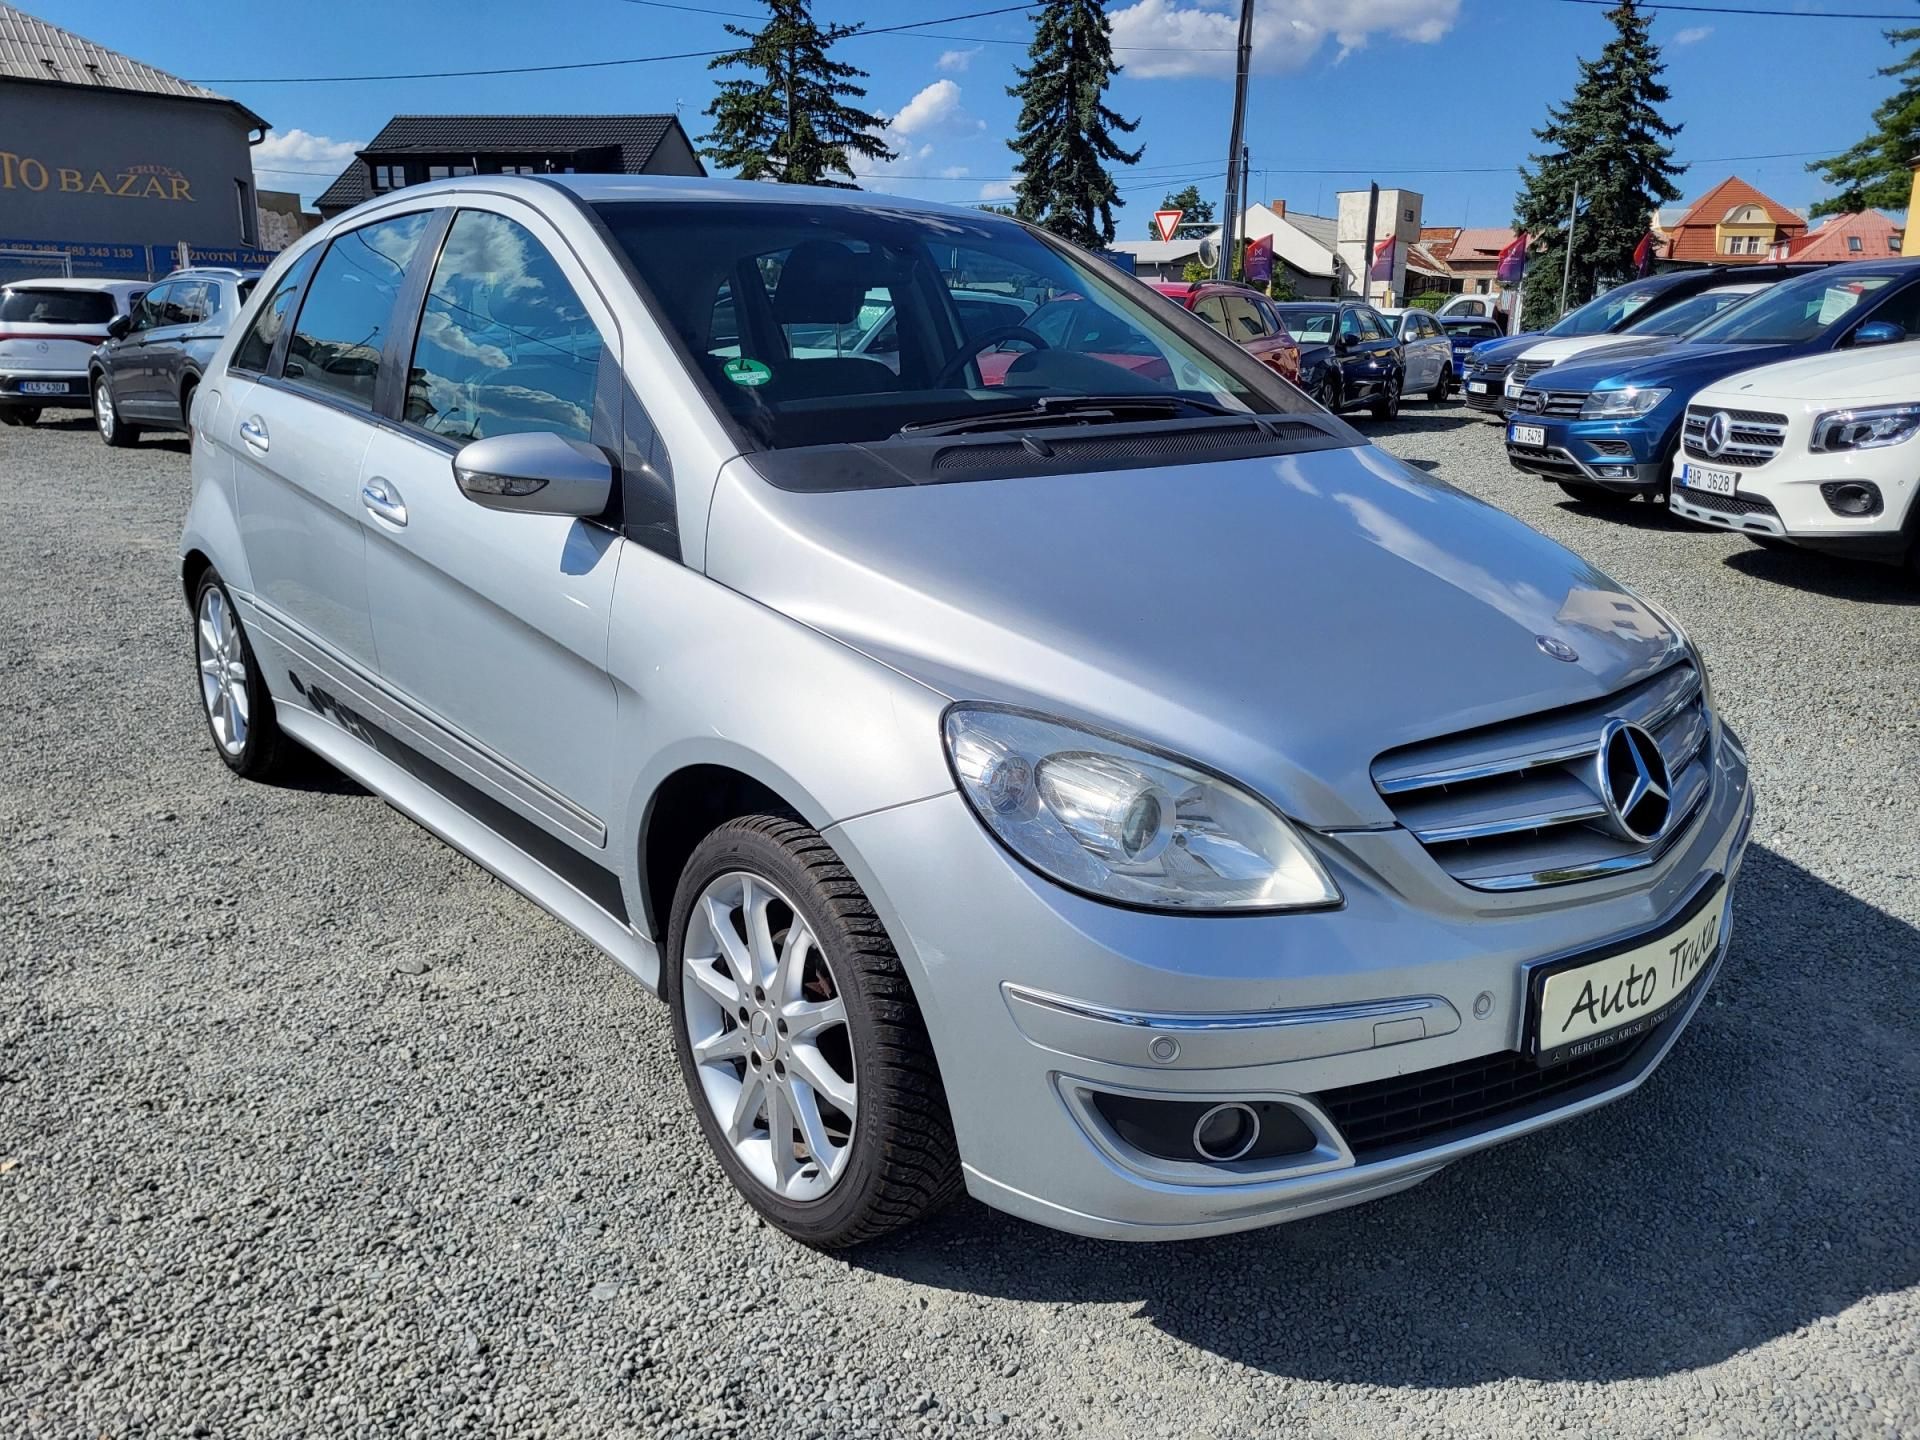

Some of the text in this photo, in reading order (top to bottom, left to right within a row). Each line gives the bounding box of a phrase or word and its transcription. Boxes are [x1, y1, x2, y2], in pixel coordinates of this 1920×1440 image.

[58, 168, 197, 202] BAZAR
[89, 247, 110, 257] 343
[113, 248, 134, 258] 133
[1688, 468, 1730, 492] 9AR 3628
[1561, 914, 1717, 1032] Auto Truxa
[1569, 1033, 1615, 1056] MERCEDES
[1618, 1023, 1644, 1041] KRUSE
